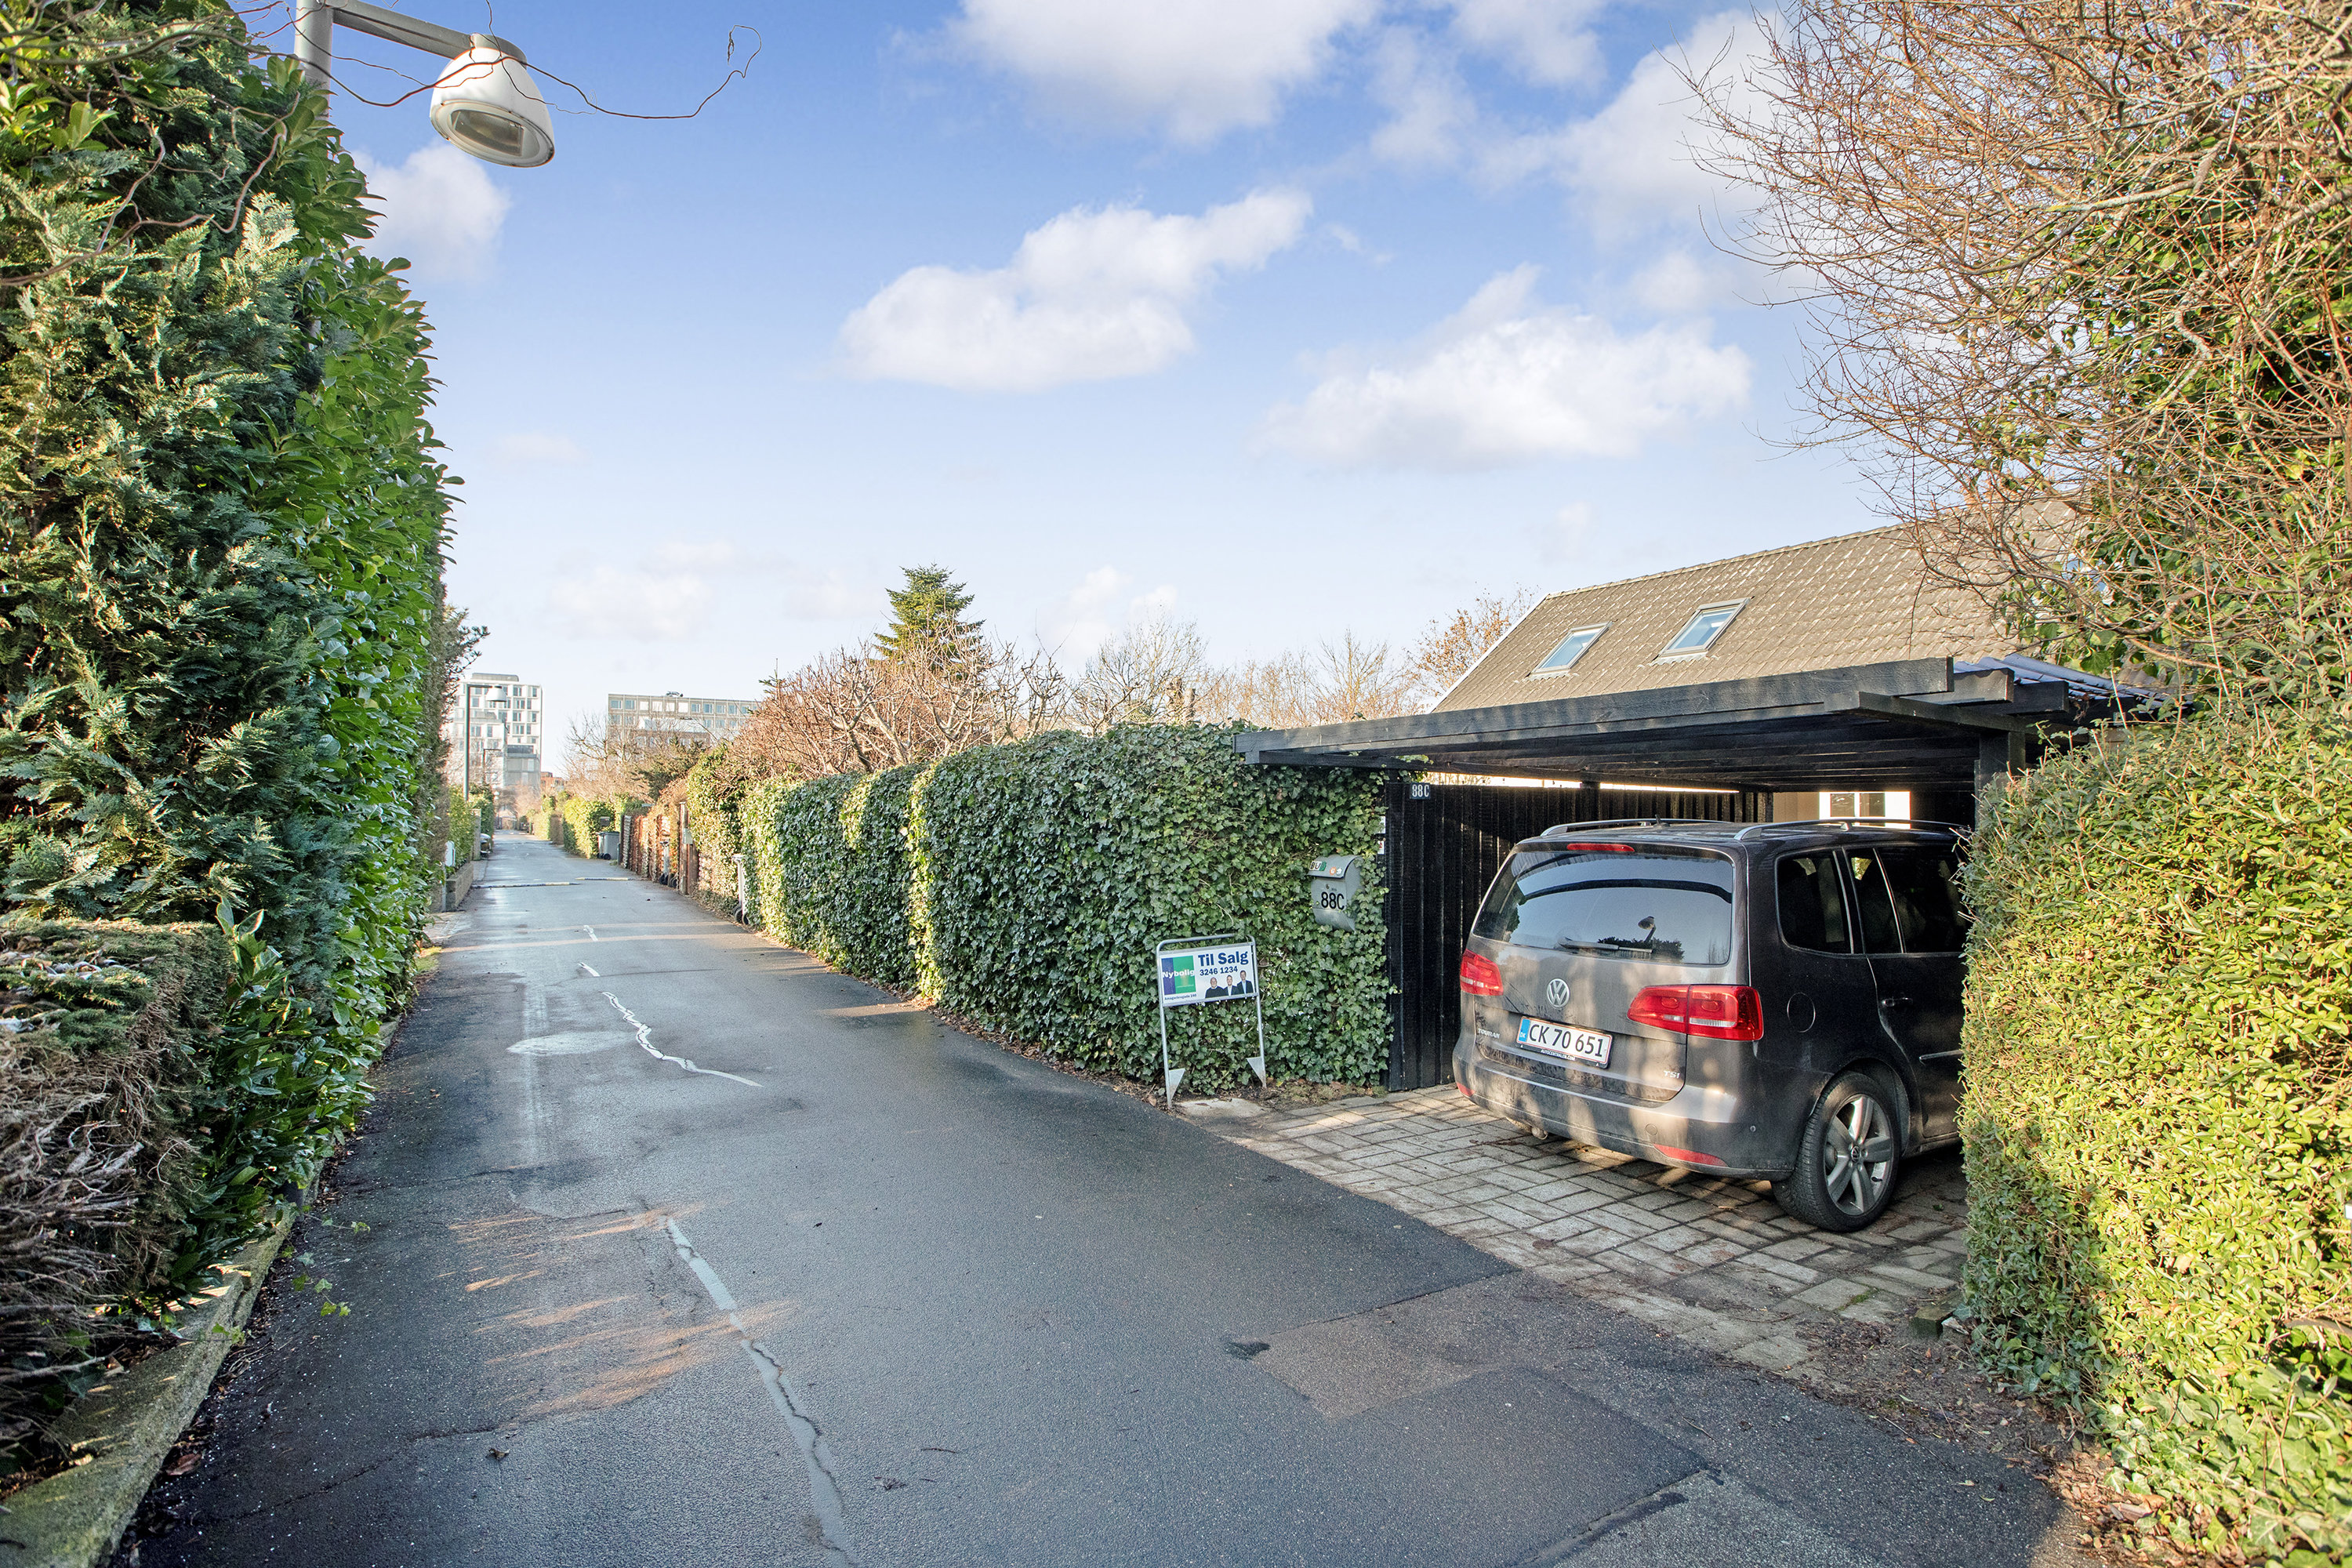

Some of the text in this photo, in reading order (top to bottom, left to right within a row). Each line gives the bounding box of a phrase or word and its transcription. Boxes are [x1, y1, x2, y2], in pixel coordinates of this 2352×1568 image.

[1412, 784, 1429, 797] 88C
[1321, 891, 1345, 910] 88C
[1198, 951, 1249, 967] Til Salg
[1162, 969, 1195, 978] Nybolig
[1200, 967, 1218, 976] 3246
[1529, 1024, 1603, 1058] CK 70 651
